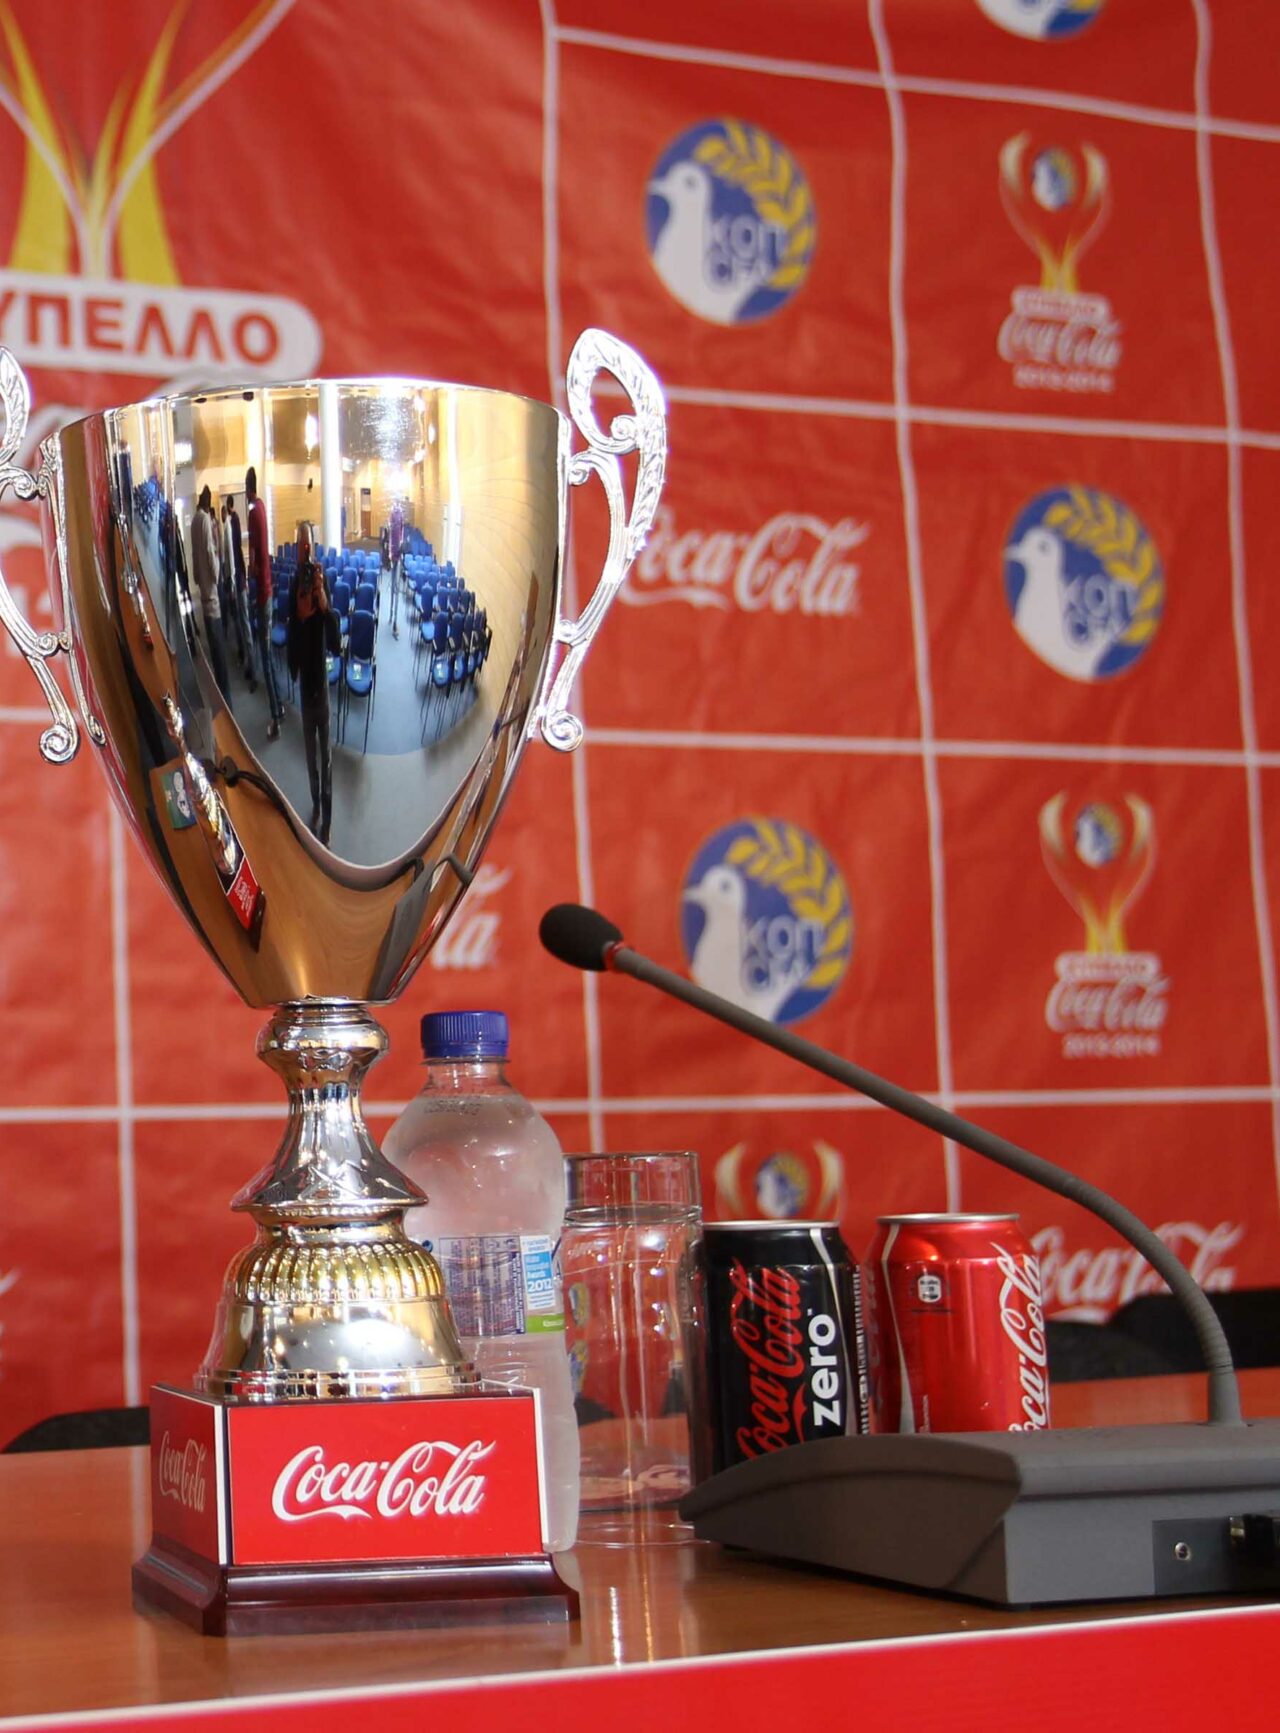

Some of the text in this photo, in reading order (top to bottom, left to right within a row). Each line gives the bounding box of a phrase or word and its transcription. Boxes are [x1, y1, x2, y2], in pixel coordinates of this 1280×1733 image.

[808, 1313, 841, 1427] zero
[989, 1241, 1052, 1432] ca-Cola
[160, 1430, 208, 1513] Coca-Cola
[271, 1439, 497, 1522] Coca-Cola
